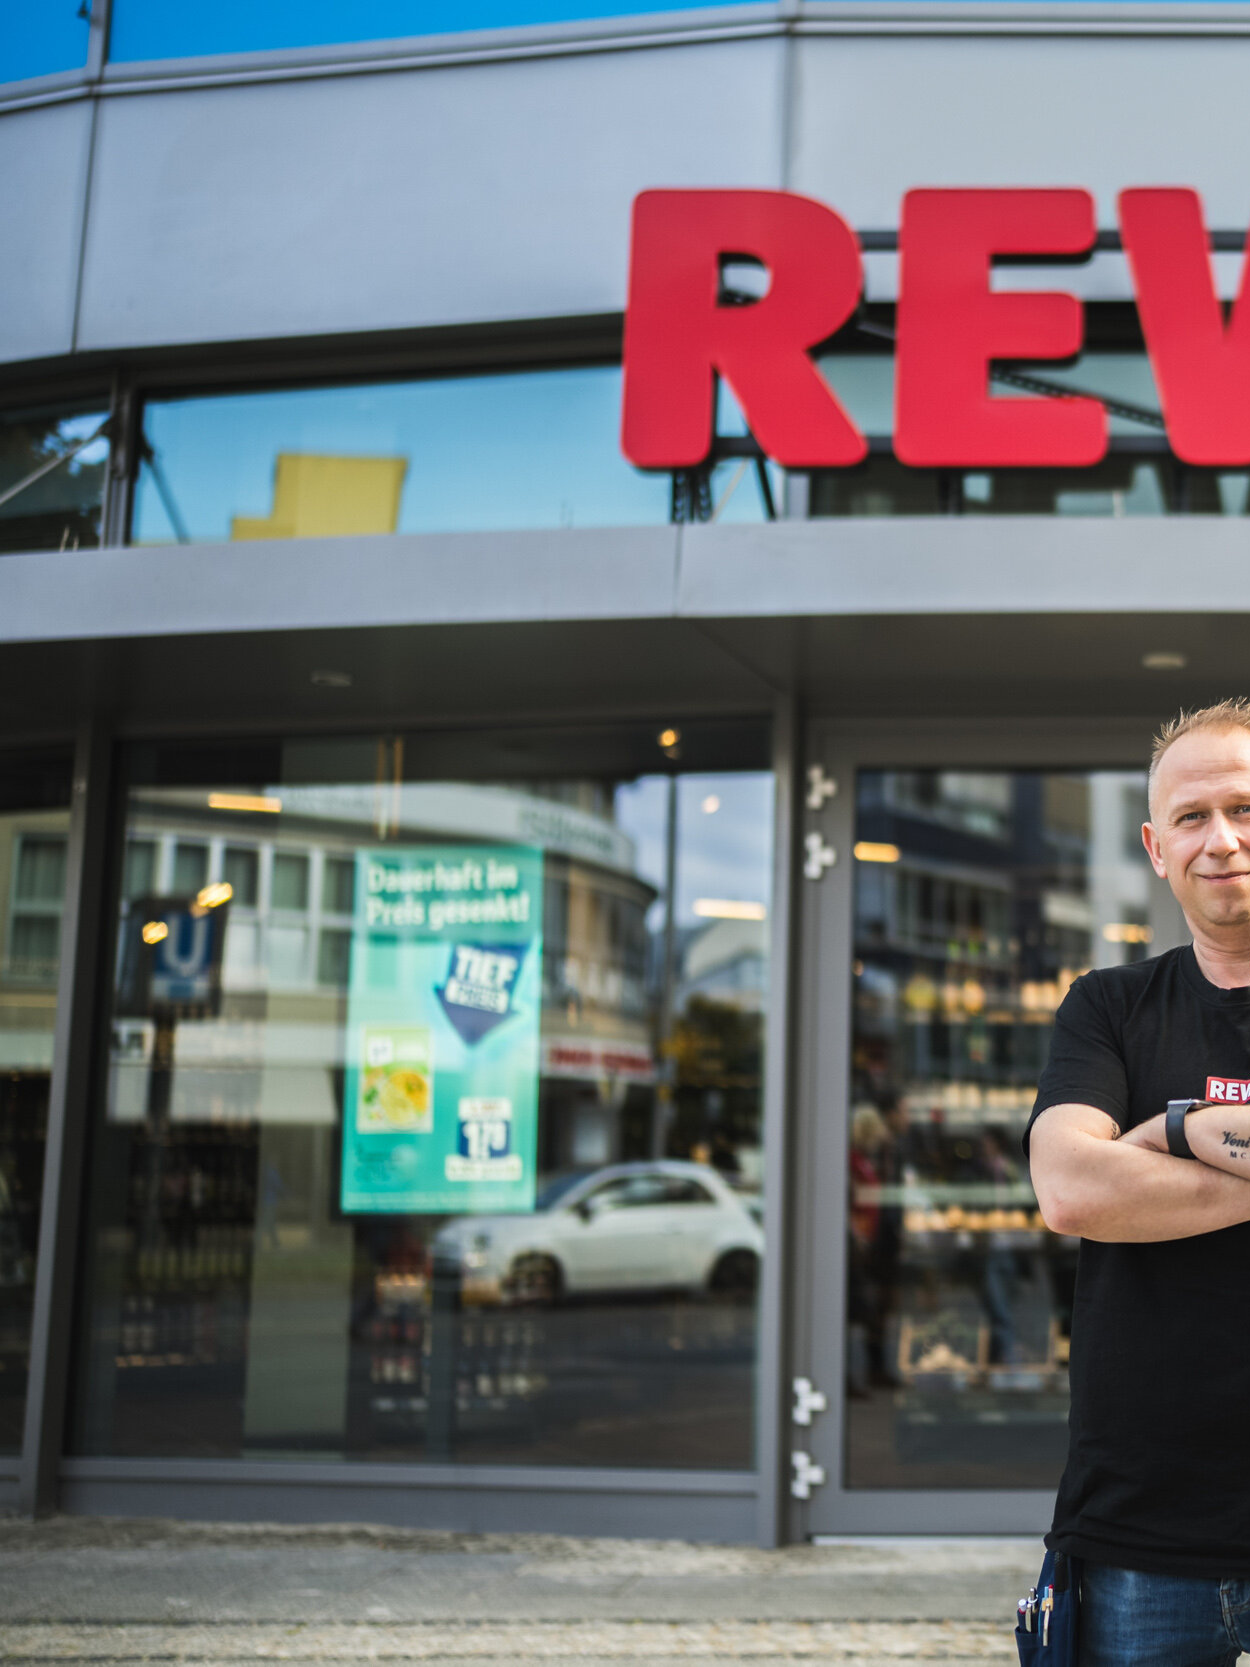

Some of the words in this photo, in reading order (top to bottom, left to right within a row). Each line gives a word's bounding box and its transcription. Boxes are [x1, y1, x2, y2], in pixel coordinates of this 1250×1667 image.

[367, 861, 483, 894] Dauerhaft
[486, 859, 518, 890] im
[367, 895, 426, 926] Preis
[428, 892, 531, 931] gesenkt!
[163, 914, 208, 974] U
[456, 946, 519, 989] TIEF
